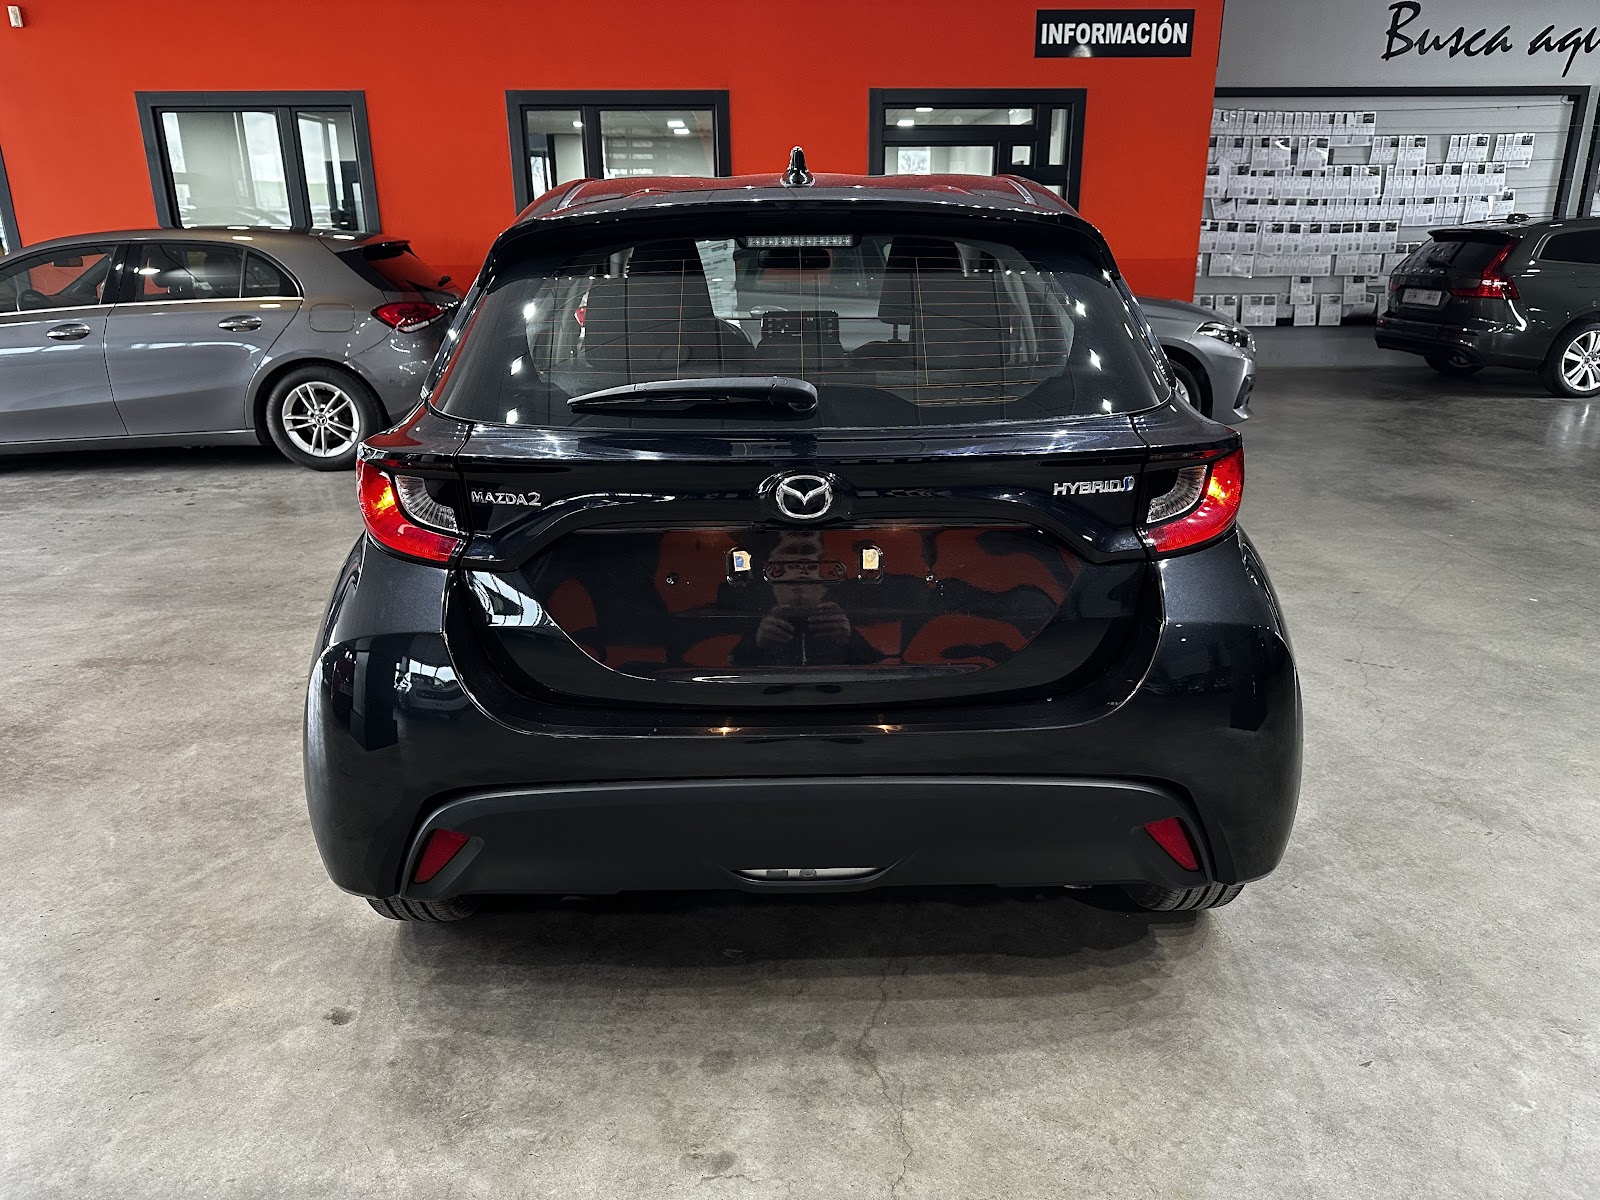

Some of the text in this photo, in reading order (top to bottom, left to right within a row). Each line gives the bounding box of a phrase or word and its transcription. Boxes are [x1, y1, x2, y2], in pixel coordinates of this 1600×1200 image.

[1041, 17, 1188, 45] INFORMACIÓN
[1381, 0, 1513, 61] Busca
[471, 490, 541, 506] MAZDA2
[1052, 479, 1123, 496] HYBRID
